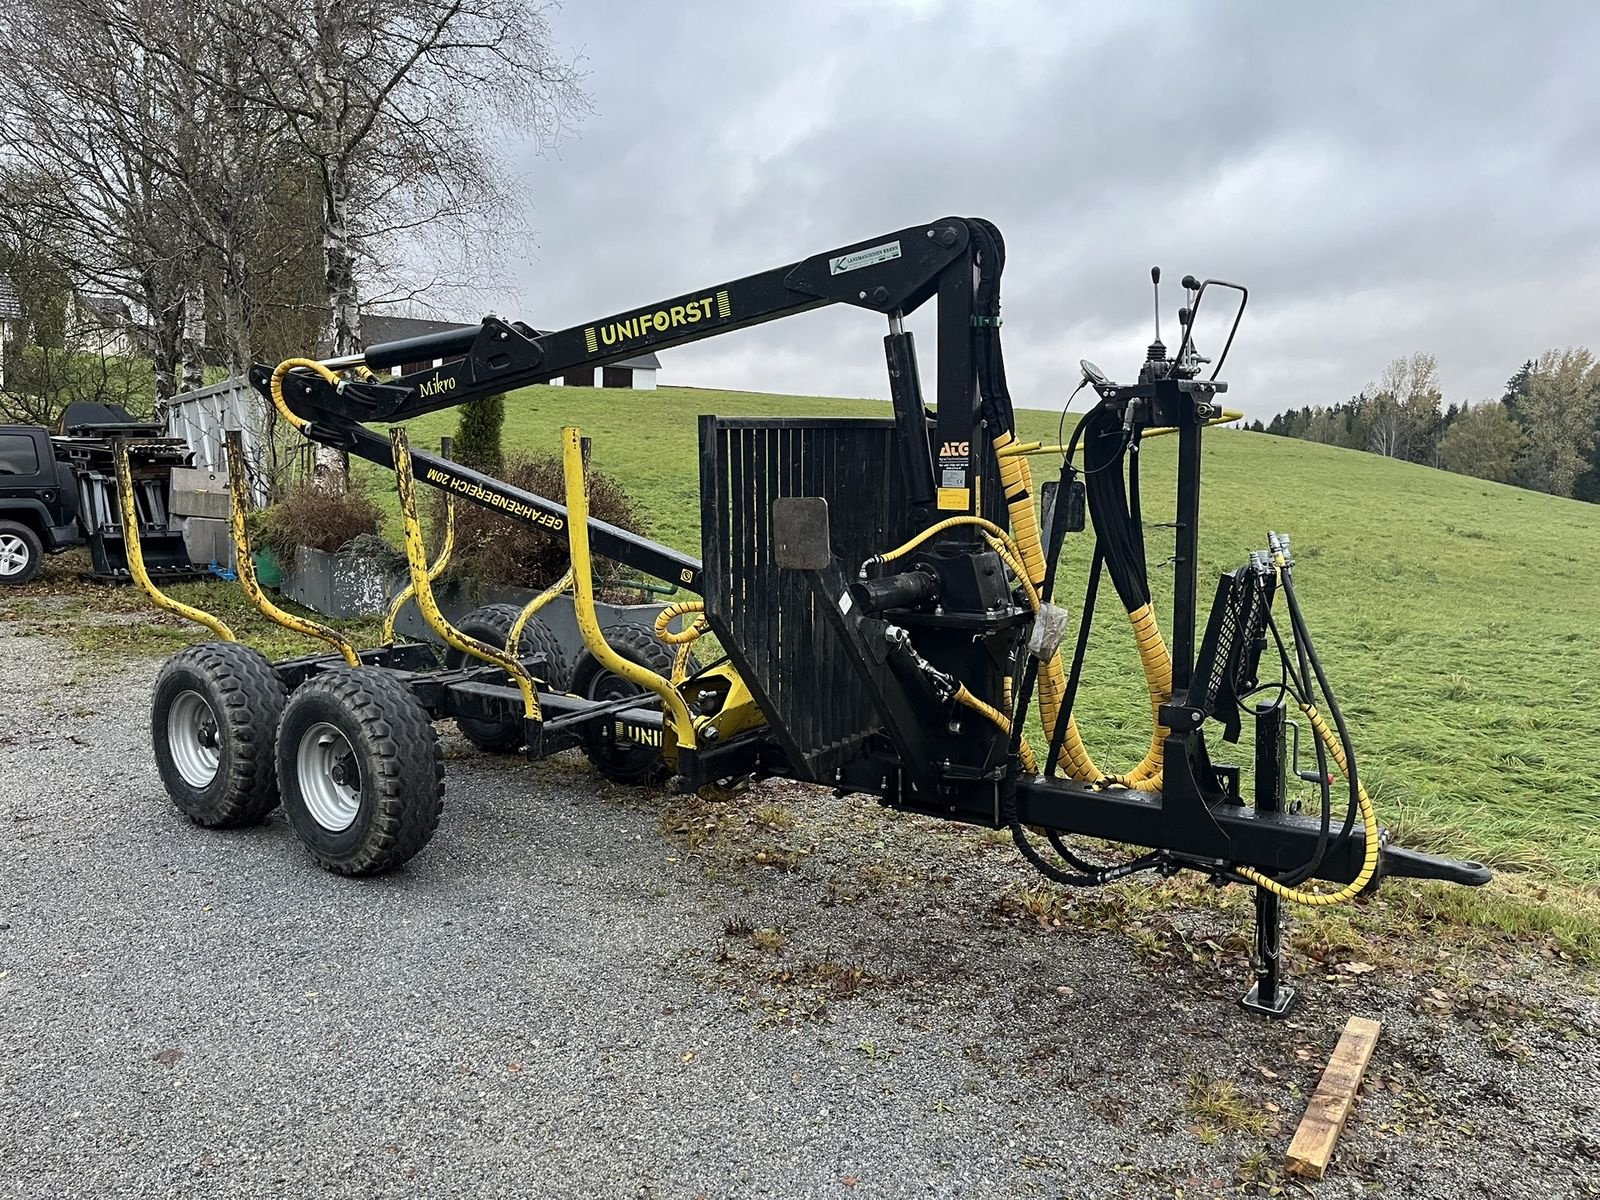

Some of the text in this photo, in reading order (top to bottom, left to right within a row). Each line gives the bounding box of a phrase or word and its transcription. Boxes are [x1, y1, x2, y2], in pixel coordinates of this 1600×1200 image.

[600, 297, 713, 346] UNIFORST
[419, 371, 456, 398] Mikro
[426, 468, 564, 531] GEFAHRENBEREICH 20M
